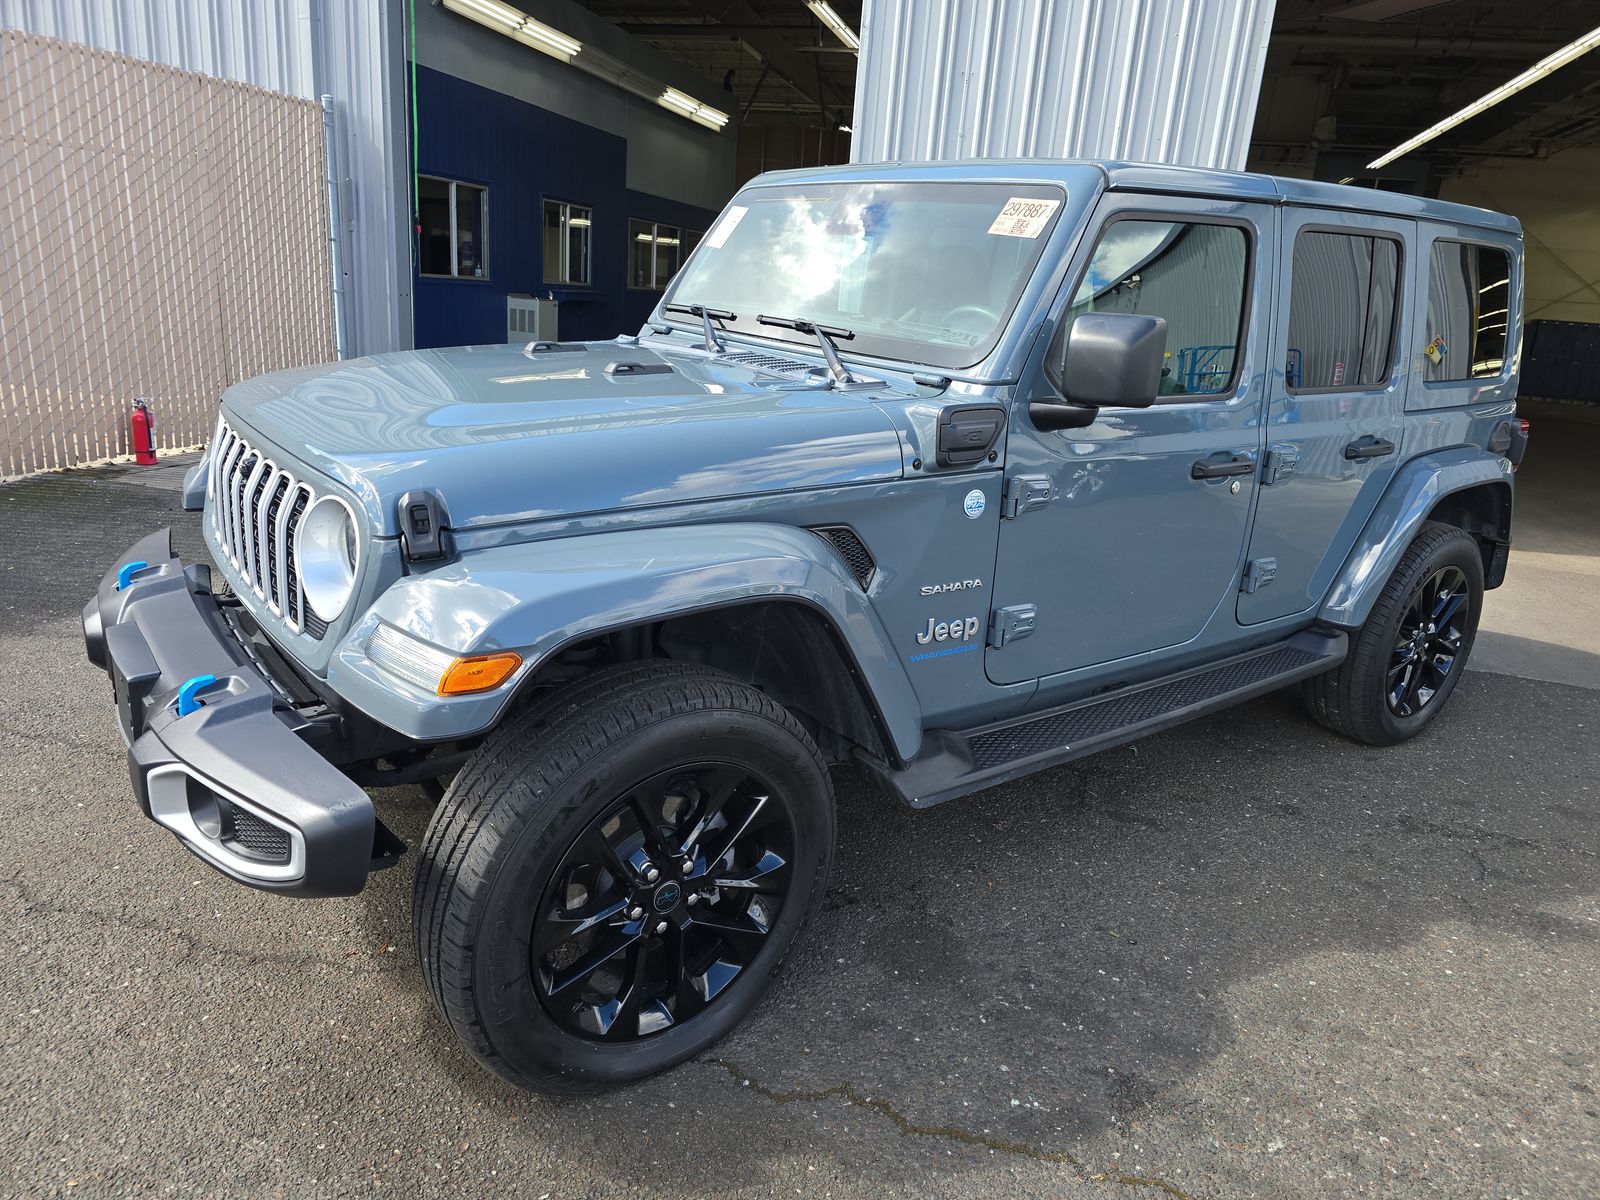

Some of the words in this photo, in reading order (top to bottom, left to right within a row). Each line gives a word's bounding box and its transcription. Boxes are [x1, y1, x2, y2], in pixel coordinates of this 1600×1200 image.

[1003, 202, 1049, 218] 297887
[920, 578, 983, 596] SAHARA
[916, 616, 980, 645] Jeep
